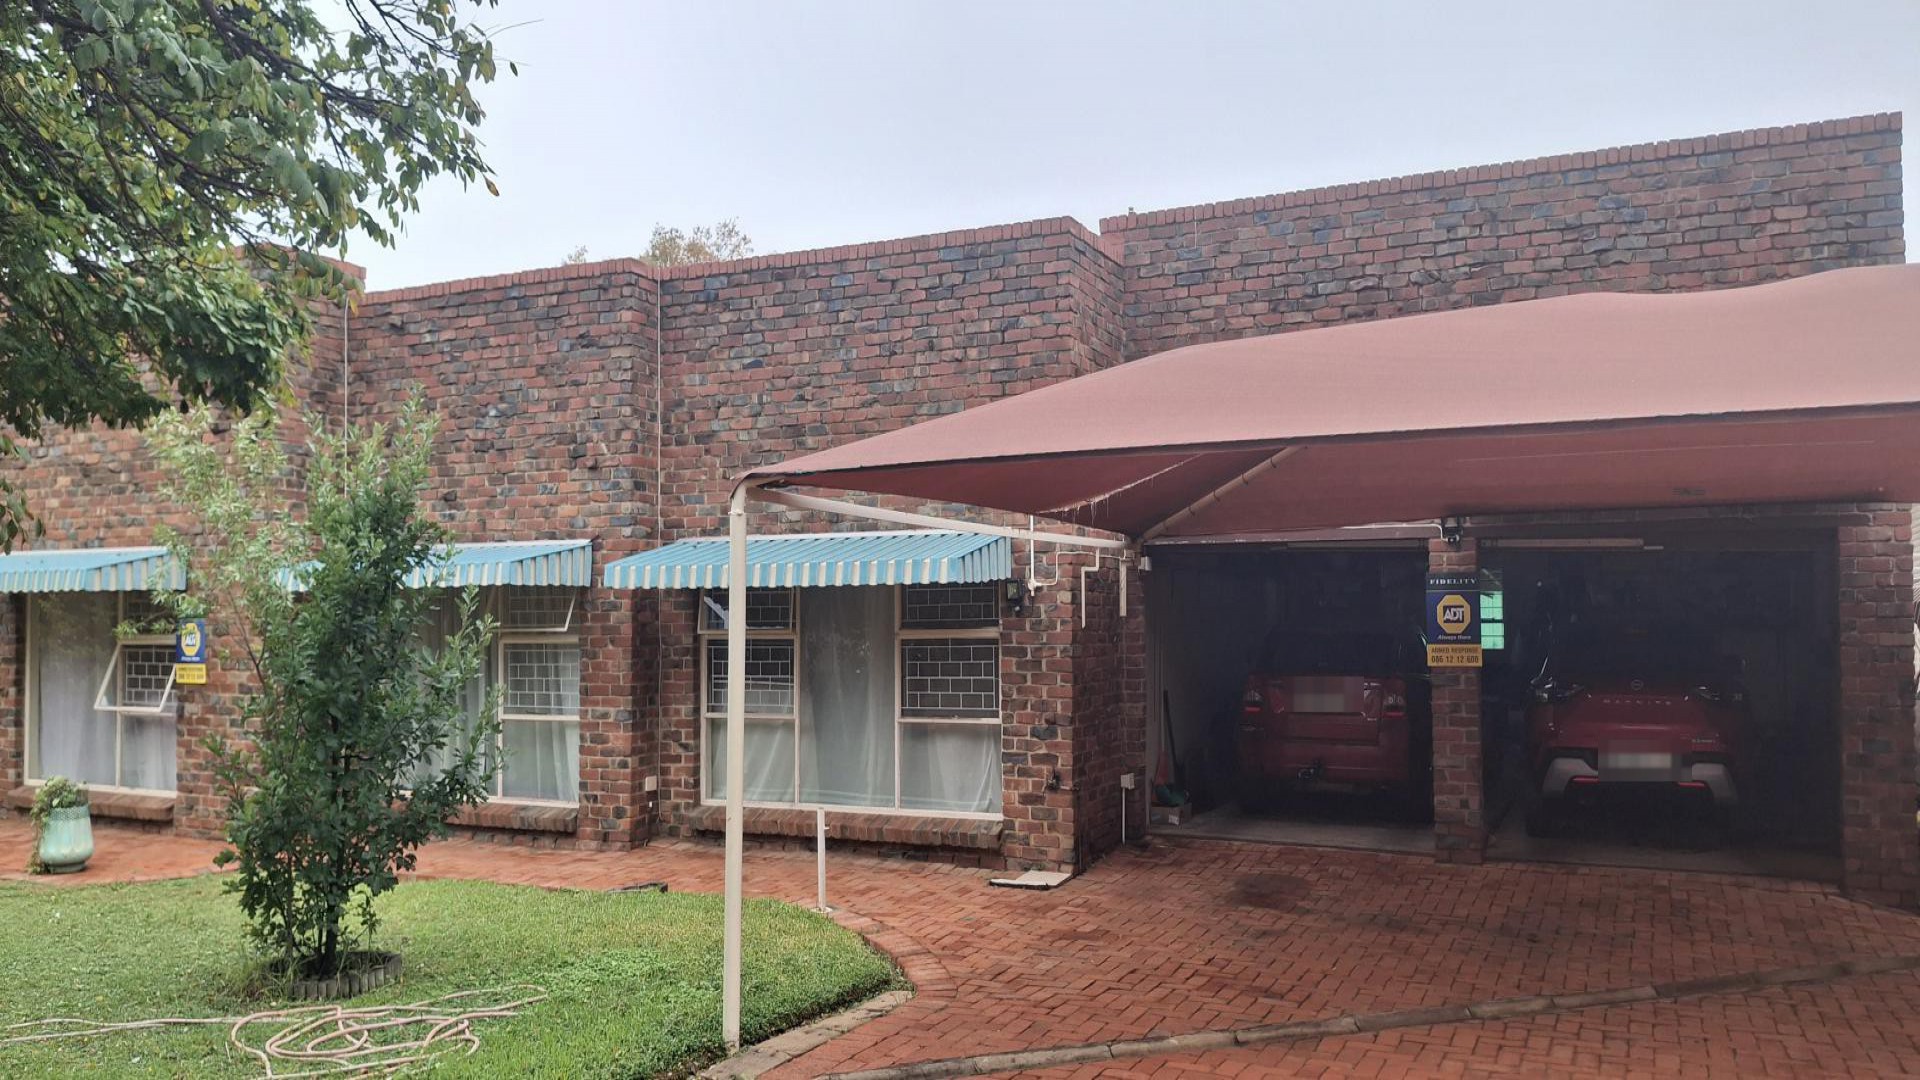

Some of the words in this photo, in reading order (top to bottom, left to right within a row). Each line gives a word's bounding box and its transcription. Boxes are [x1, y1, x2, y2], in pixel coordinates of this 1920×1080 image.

[1444, 607, 1464, 621] ADT
[1431, 655, 1444, 663] 086
[1446, 655, 1454, 663] 12
[1456, 655, 1465, 663] 12
